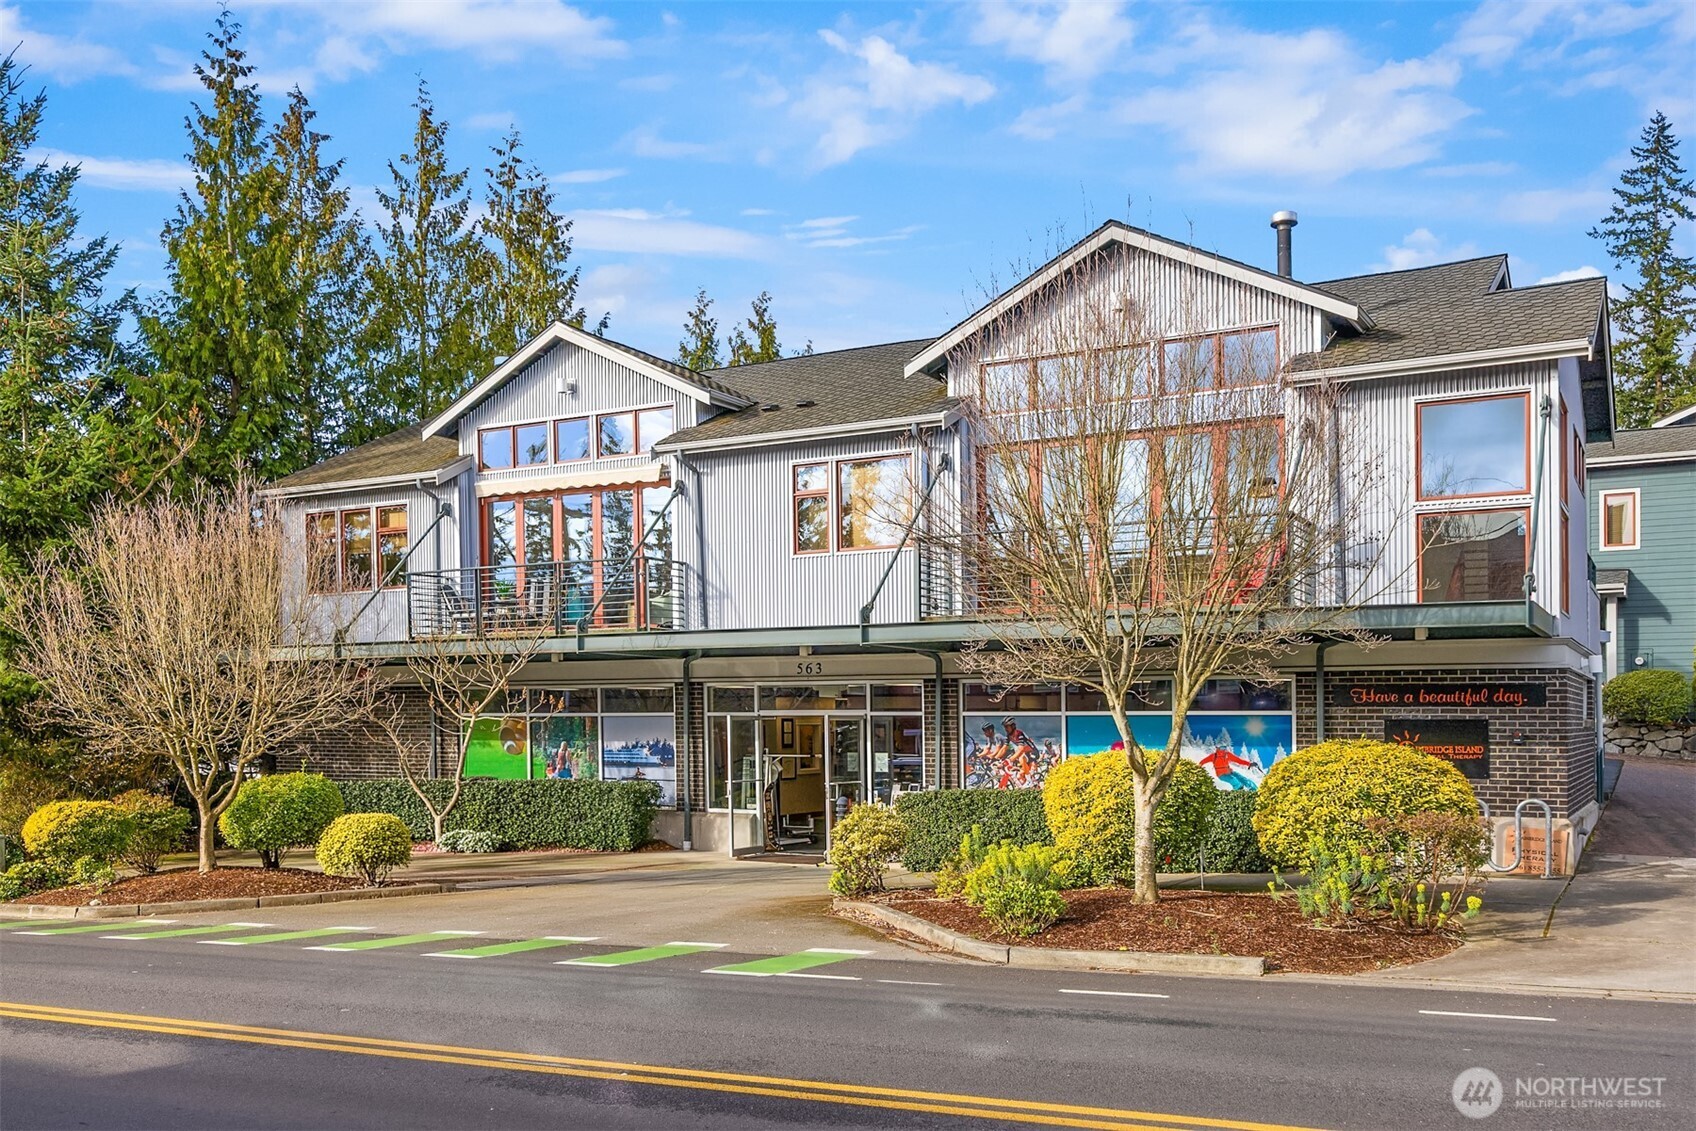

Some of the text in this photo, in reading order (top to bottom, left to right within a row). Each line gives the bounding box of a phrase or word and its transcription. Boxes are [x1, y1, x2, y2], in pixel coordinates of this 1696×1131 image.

[796, 662, 822, 675] 563
[1350, 688, 1528, 706] Have a beautiful day.
[1455, 745, 1484, 754] ISLAND
